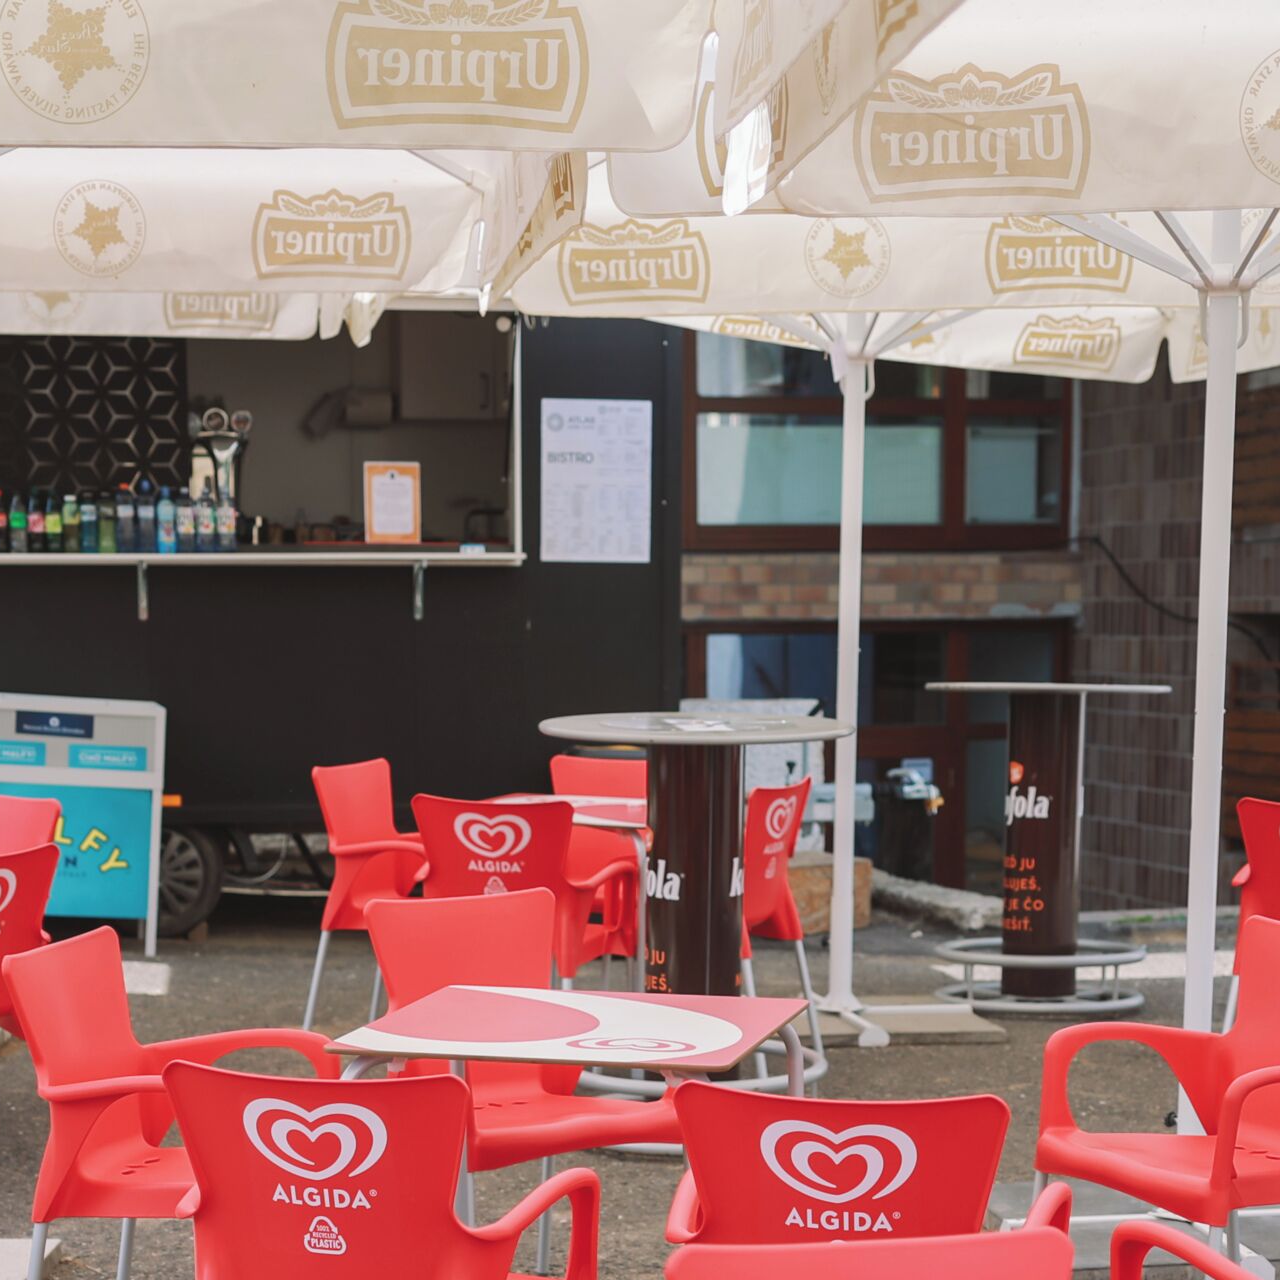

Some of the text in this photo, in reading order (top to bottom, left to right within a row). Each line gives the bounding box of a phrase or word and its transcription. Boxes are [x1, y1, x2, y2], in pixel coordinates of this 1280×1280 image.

[547, 451, 595, 464] BISTRO
[1005, 786, 1049, 826] fola
[53, 815, 129, 872] LFY
[468, 859, 522, 873] ALGIDA
[646, 858, 681, 901] ola
[272, 1183, 371, 1209] ALGIDA
[784, 1206, 894, 1232] ALGIDA
[311, 1238, 341, 1249] PLASTIC
